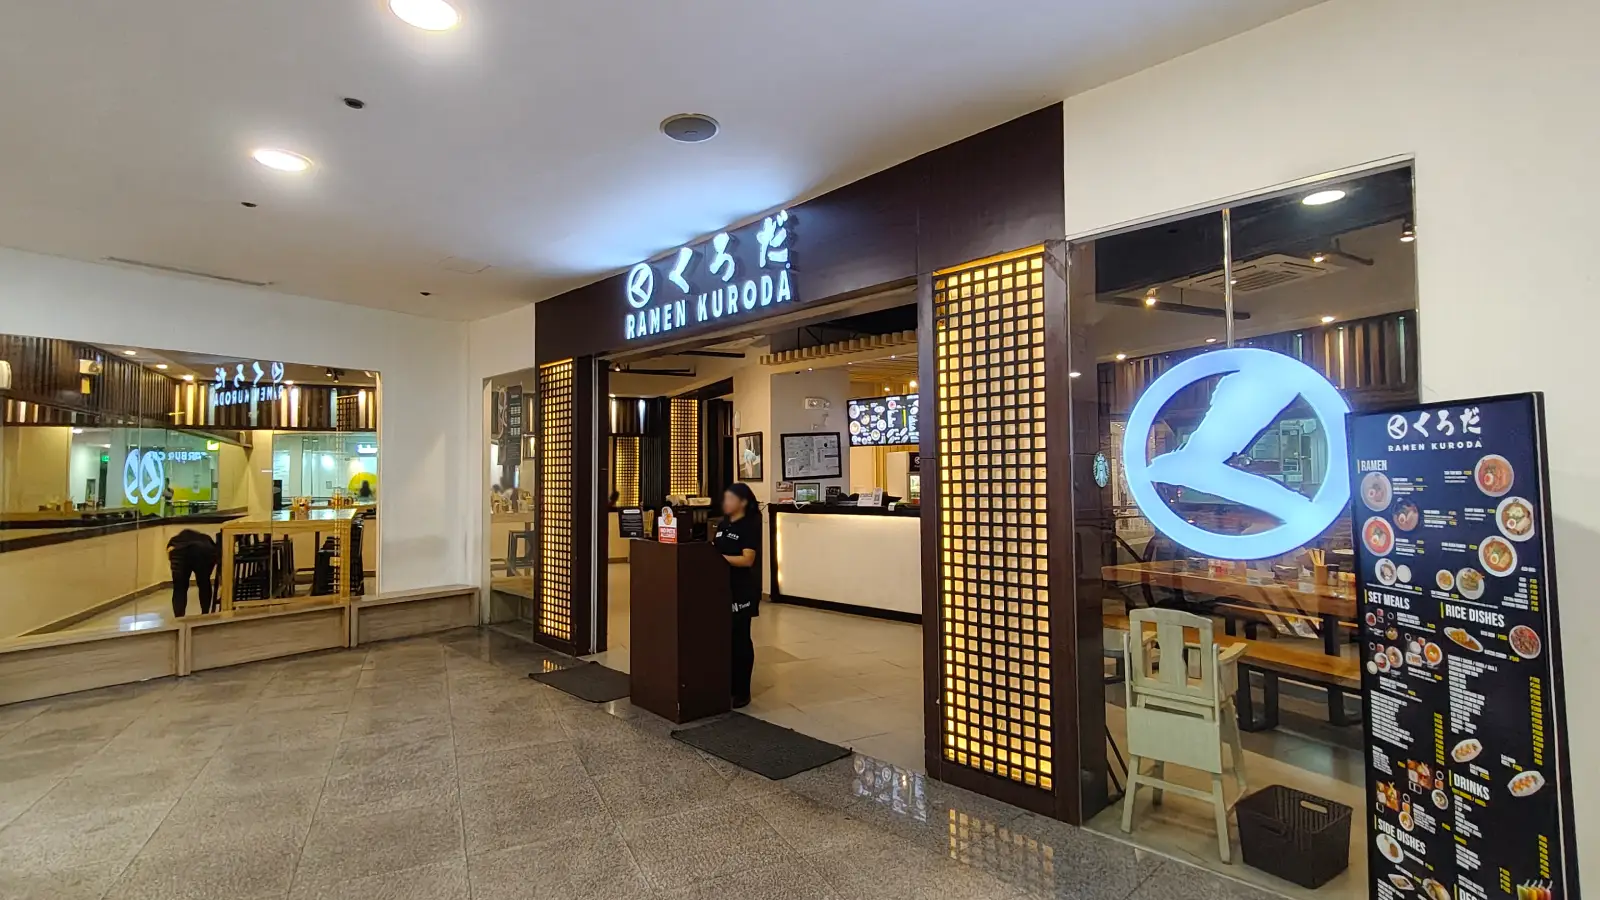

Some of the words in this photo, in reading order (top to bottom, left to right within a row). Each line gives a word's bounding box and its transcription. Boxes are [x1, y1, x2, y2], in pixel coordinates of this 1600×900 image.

[668, 209, 789, 294] くろだ
[626, 299, 687, 340] RAMEN
[697, 269, 792, 323] KURODA
[1412, 406, 1482, 438] くろだ
[1388, 442, 1425, 452] RAMEN
[1431, 440, 1483, 450] KURODA
[1360, 459, 1388, 472] RAMEN
[1368, 591, 1382, 604] SET
[1383, 594, 1410, 610] MEALS
[1445, 604, 1467, 621] RICE
[1469, 608, 1505, 628] DISHES
[1453, 773, 1491, 801] DRINKS
[1377, 818, 1396, 838] SIDE
[1396, 828, 1426, 856] DISHES
